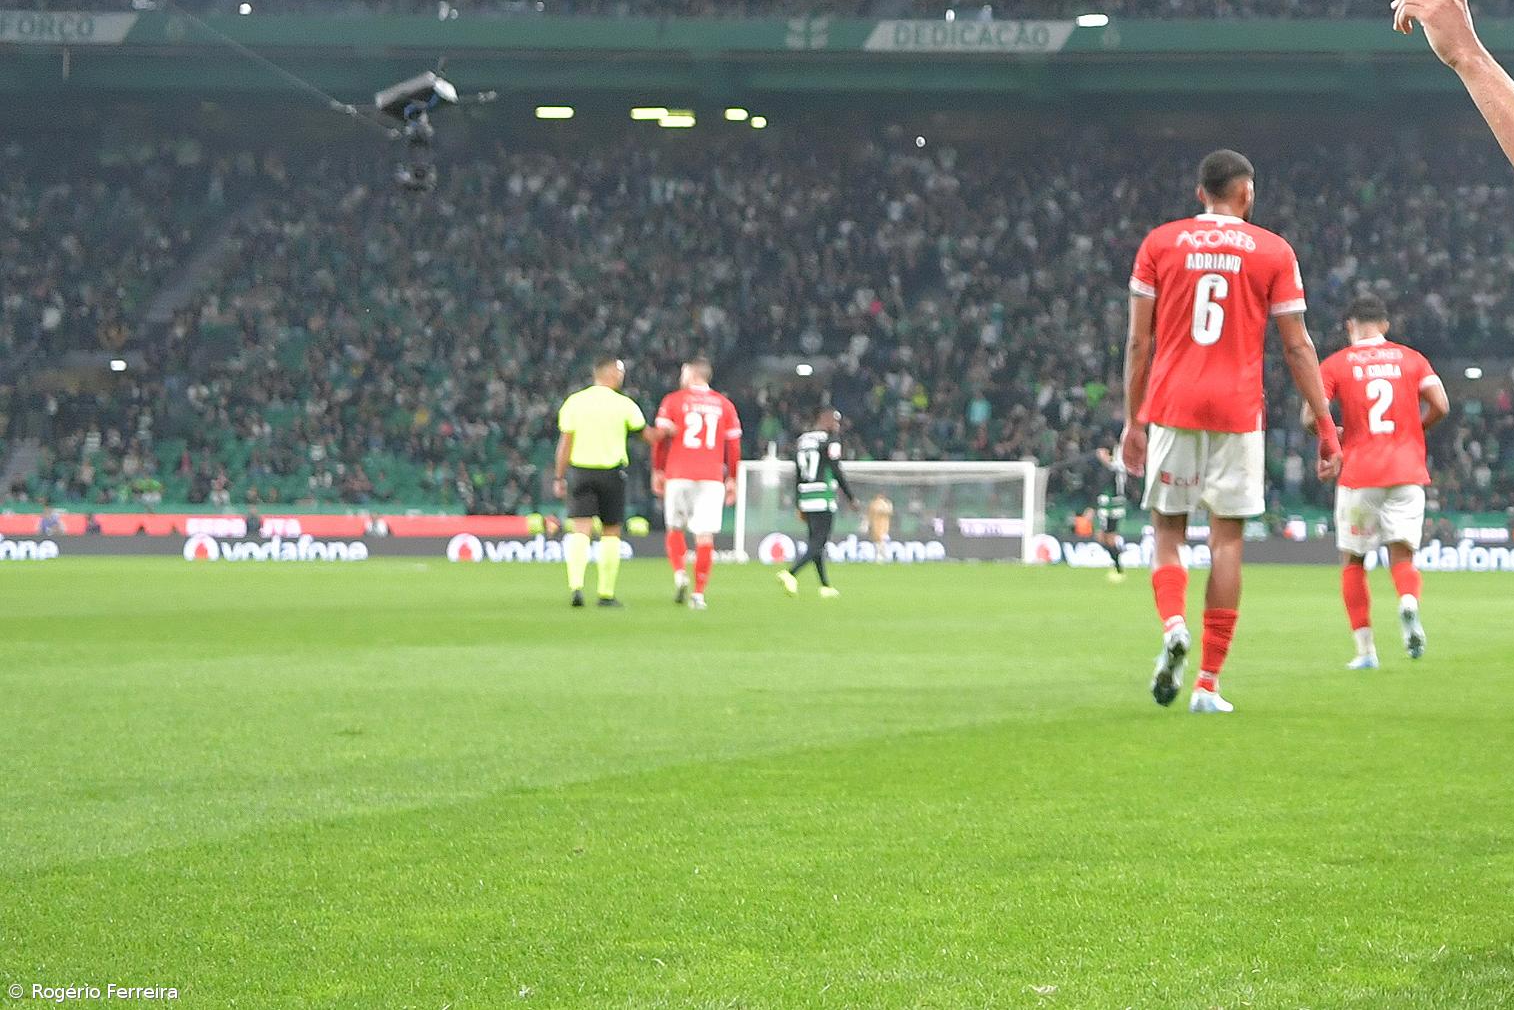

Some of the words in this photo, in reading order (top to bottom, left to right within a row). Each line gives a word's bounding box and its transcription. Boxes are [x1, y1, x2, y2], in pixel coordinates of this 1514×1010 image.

[1191, 273, 1228, 346] 6
[1366, 378, 1395, 434] 2
[683, 411, 718, 449] 21
[220, 535, 369, 561] vodafone
